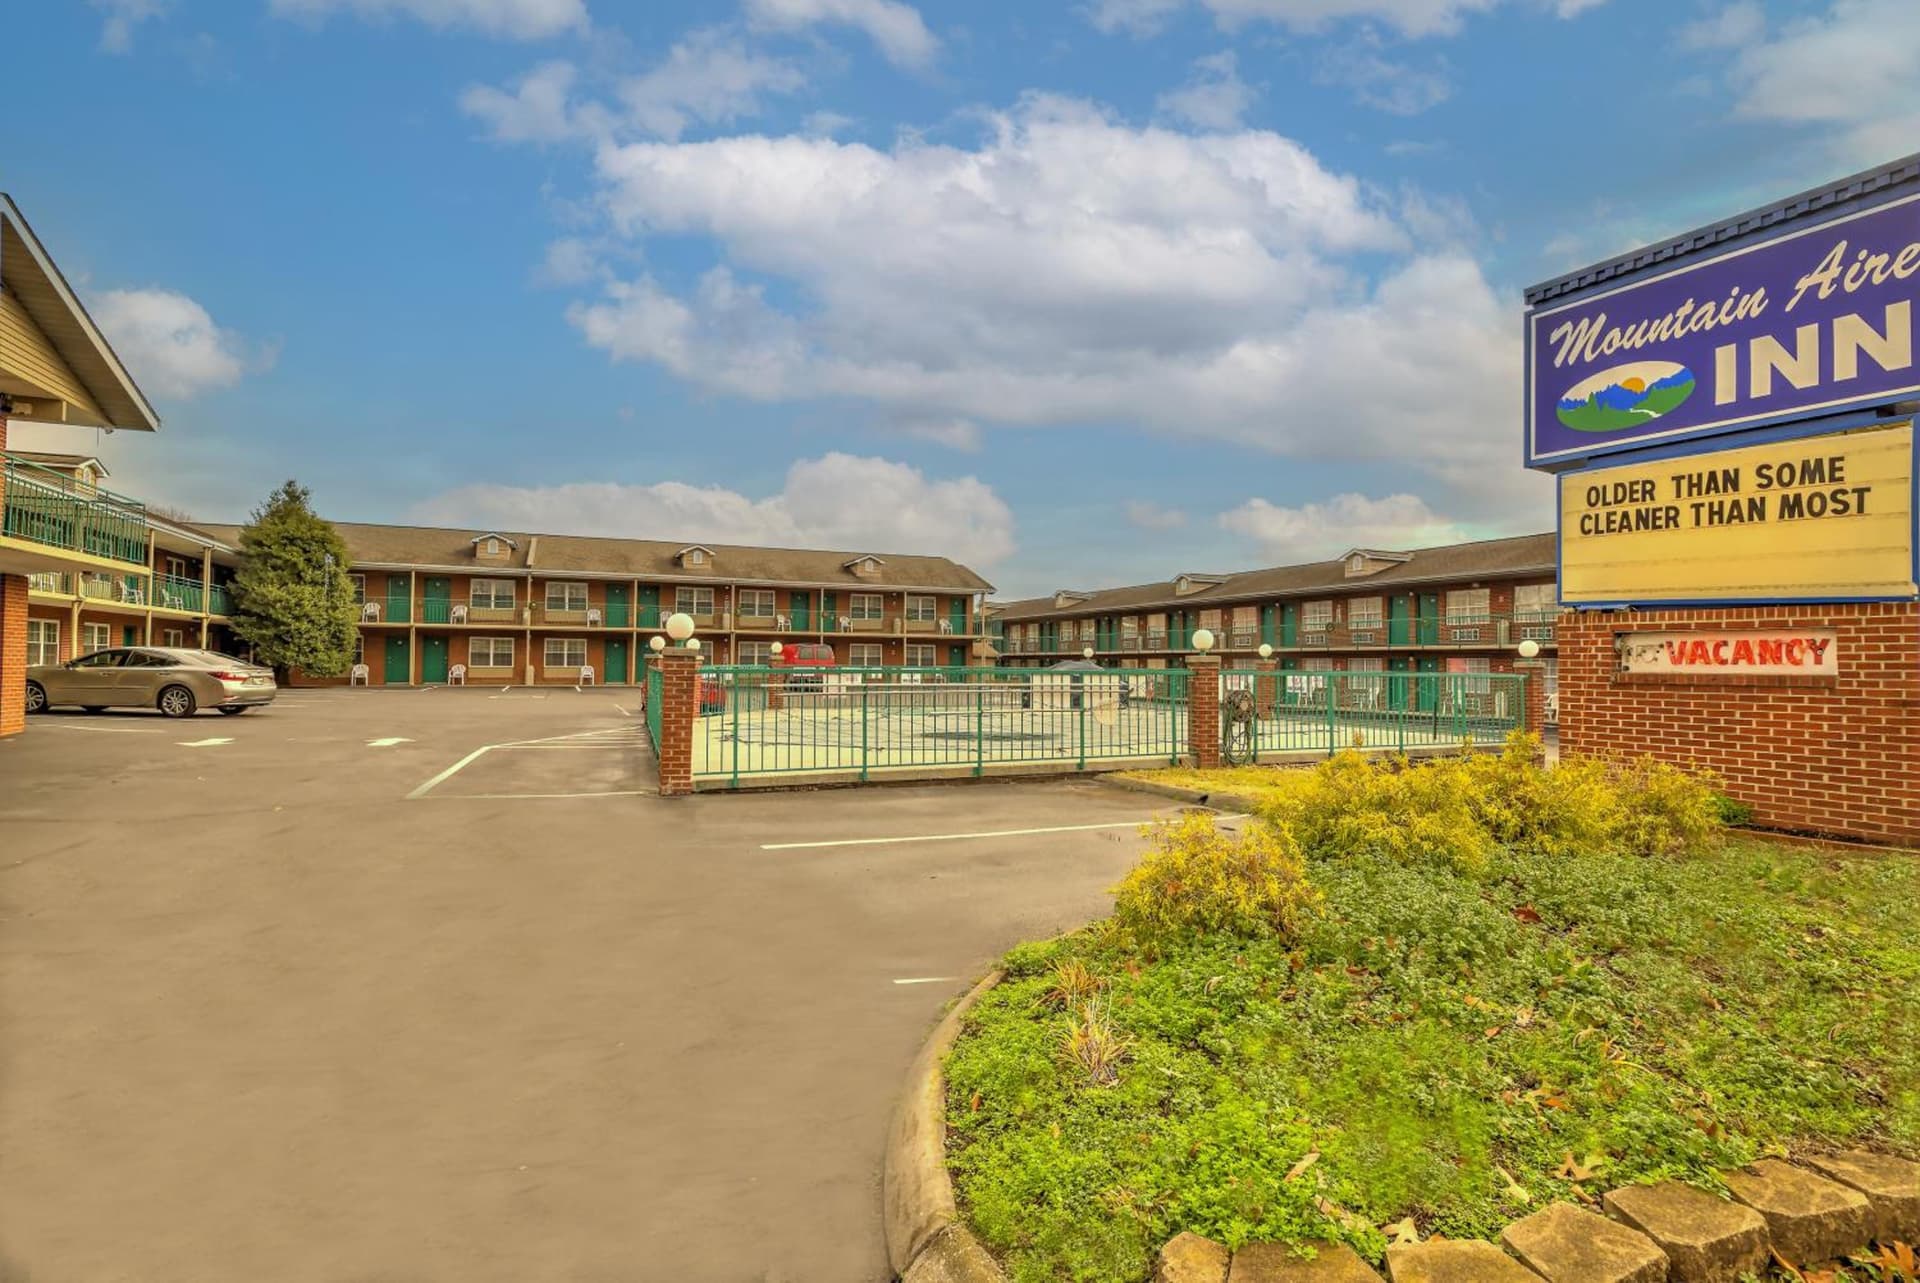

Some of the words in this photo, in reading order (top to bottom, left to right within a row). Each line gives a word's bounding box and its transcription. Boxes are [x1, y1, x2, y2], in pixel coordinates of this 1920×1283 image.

[1550, 286, 1769, 368] Mountain
[1785, 240, 1920, 312] Aire
[1715, 299, 1912, 406] INN
[1586, 479, 1656, 508] OLDER
[1671, 468, 1740, 498] THAN
[1755, 456, 1845, 489] SOME
[1580, 505, 1680, 535] CLEANER
[1690, 496, 1766, 527] THAN
[1778, 487, 1871, 519] MOST
[1666, 638, 1831, 666] VACANCY
